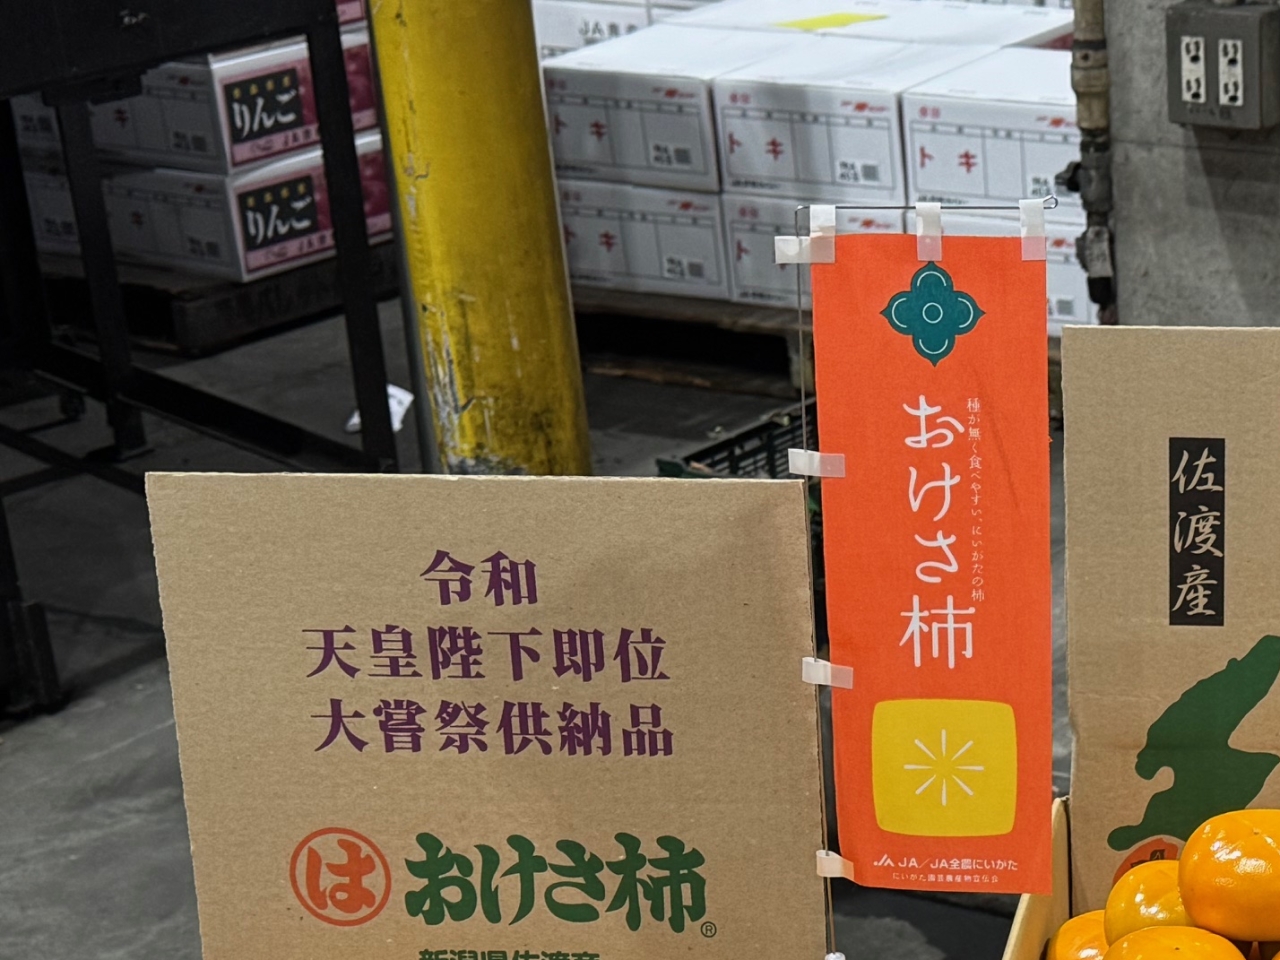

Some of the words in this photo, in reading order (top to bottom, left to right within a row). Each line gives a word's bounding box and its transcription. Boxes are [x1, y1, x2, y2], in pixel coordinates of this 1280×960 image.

[232, 89, 298, 138] りんご
[728, 132, 784, 160] トキ
[919, 145, 978, 174] トキ
[246, 196, 313, 245] りんご
[898, 394, 977, 669] おけさ柿
[1171, 450, 1224, 617] 佐渡産
[420, 549, 539, 607] 令和
[301, 624, 671, 684] 天皇陛下即位
[310, 699, 674, 757] 大嘗祭供納品
[404, 832, 706, 934] おけさ柿
